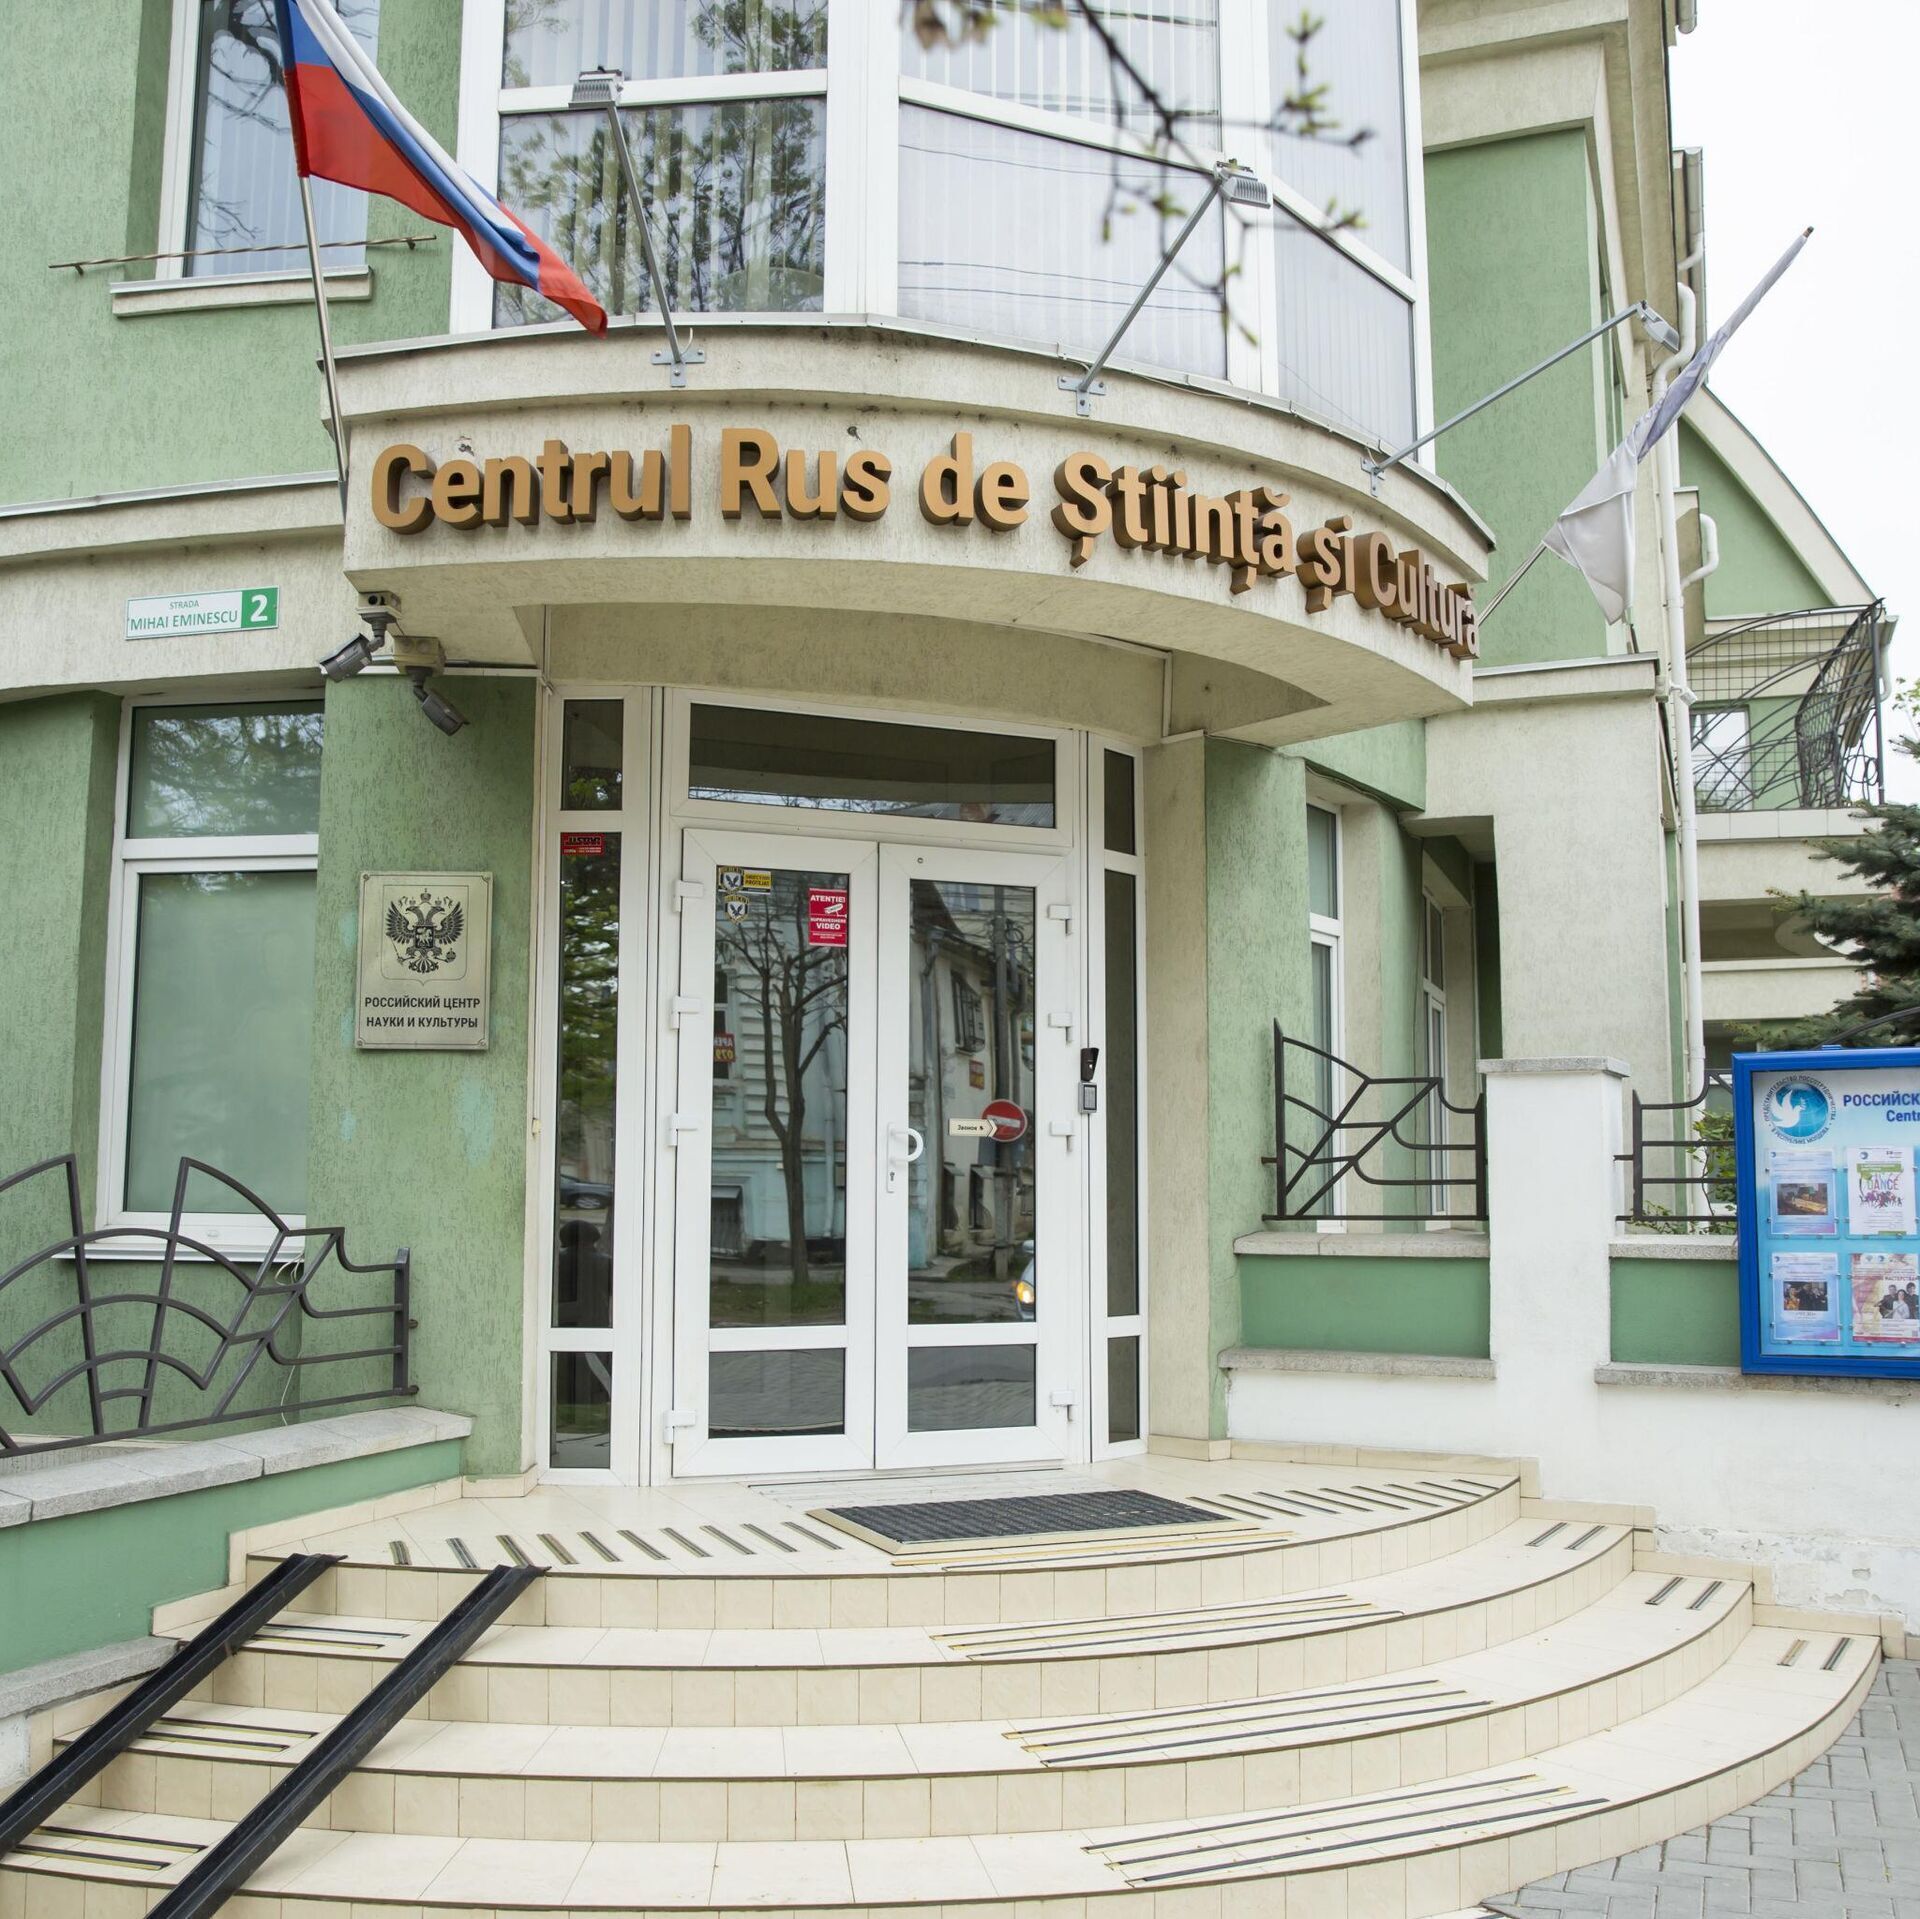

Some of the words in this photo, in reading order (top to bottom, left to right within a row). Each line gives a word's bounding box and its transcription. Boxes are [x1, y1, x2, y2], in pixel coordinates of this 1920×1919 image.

[371, 424, 691, 534] Centrul
[721, 428, 892, 521] Rus
[919, 432, 1030, 531] de
[1052, 451, 1294, 594] Știință
[169, 599, 200, 610] STRADA
[250, 594, 268, 623] 2
[130, 615, 169, 631] MIHAI
[173, 610, 238, 628] EMINESCU
[816, 922, 841, 930] VIDEO
[365, 995, 440, 1008] РОССИЙСКИЙ
[444, 997, 480, 1010] ЦЕНТР
[366, 1017, 404, 1028] НАУКИ
[407, 1017, 415, 1028] И
[418, 1017, 478, 1028] КУЛЬТУРЫ
[1843, 1090, 1920, 1107] РОССИЙСК
[1867, 1178, 1900, 1191] DANCE
